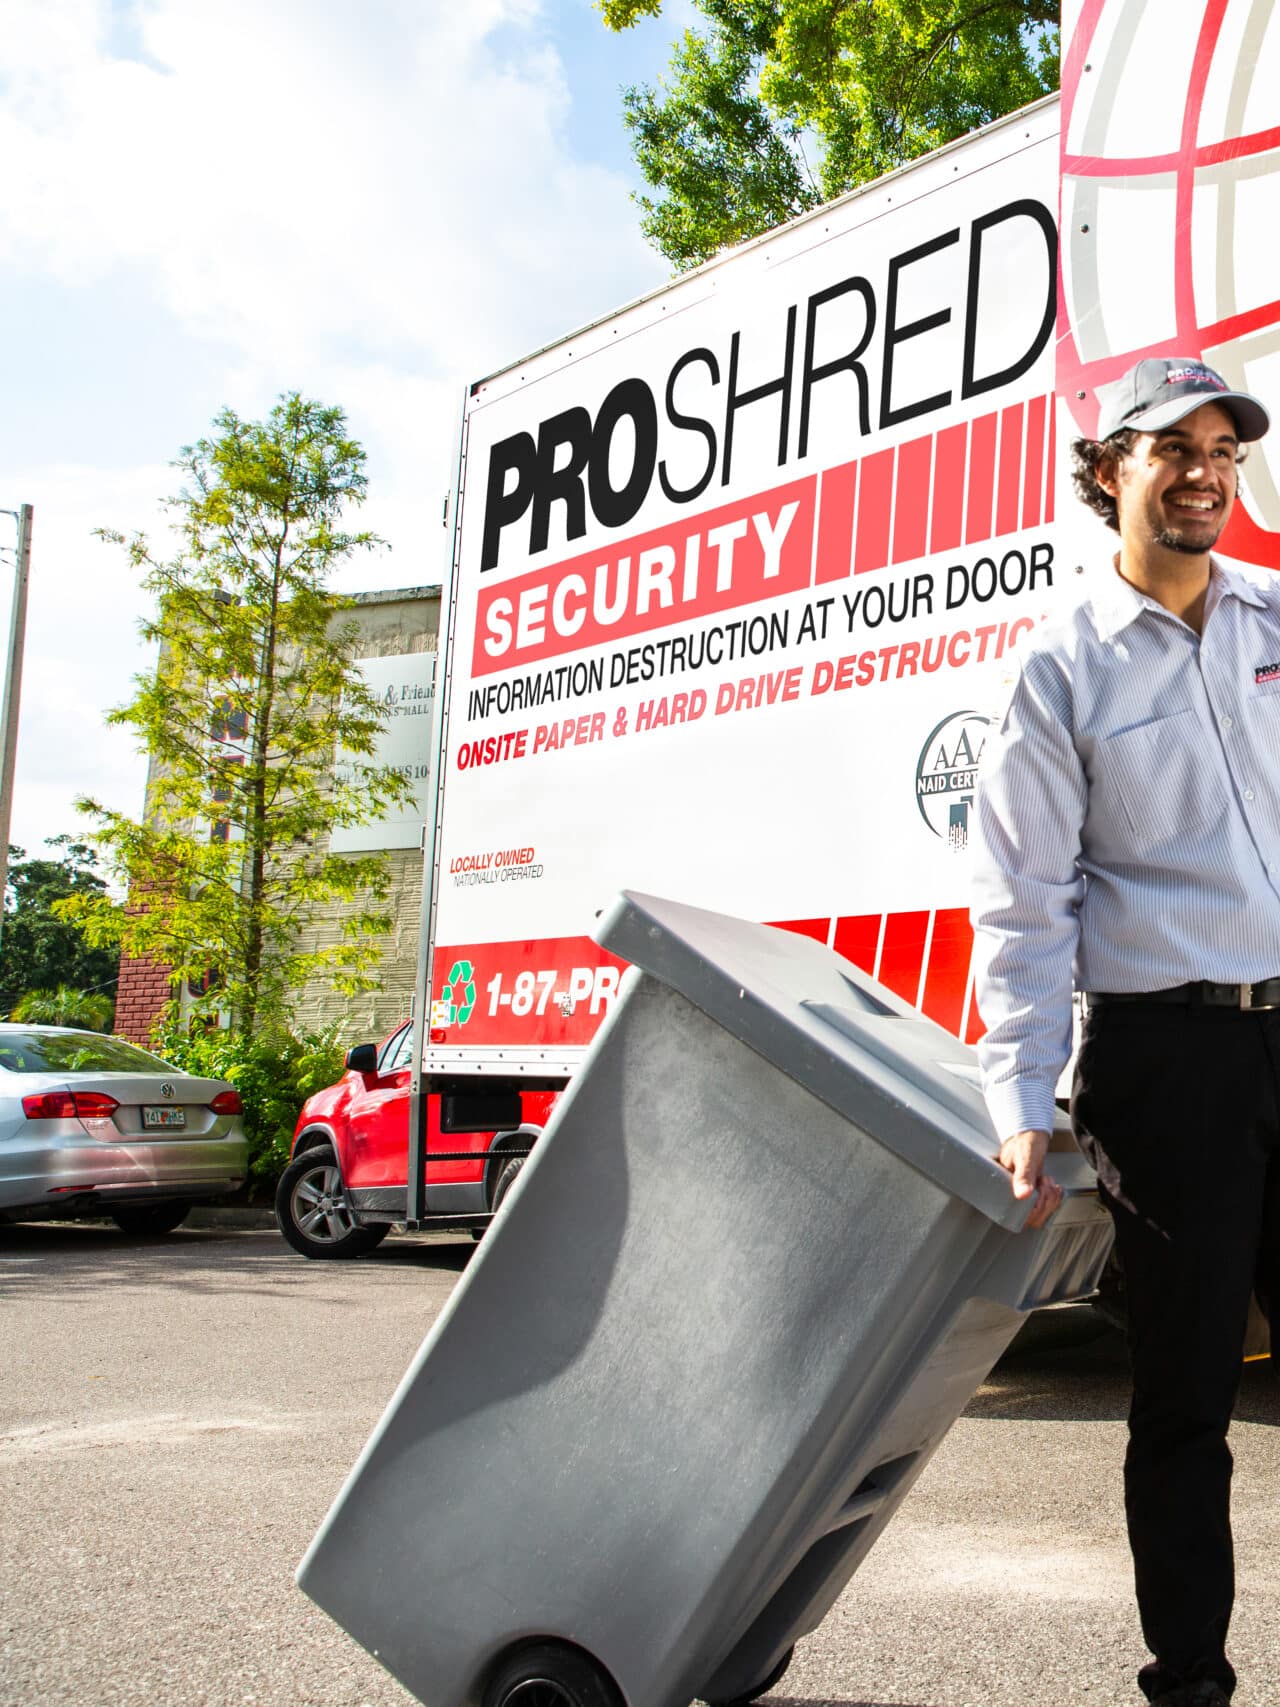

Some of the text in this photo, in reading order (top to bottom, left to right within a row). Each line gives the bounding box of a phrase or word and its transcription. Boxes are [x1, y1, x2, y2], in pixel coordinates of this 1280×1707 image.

[480, 199, 1058, 573] PROSHRED
[468, 543, 1055, 721] INFORMATION DESTRUCTION AT YOUR DOOR
[484, 501, 800, 657] SECURITY
[457, 614, 1047, 771] ONSITE PAPER & HARD DRIVE DESTRUCTIO
[450, 847, 535, 874] LOCALLY OWNED
[918, 775, 947, 794] NAID
[453, 864, 544, 887] NATIONALLY OPERATED
